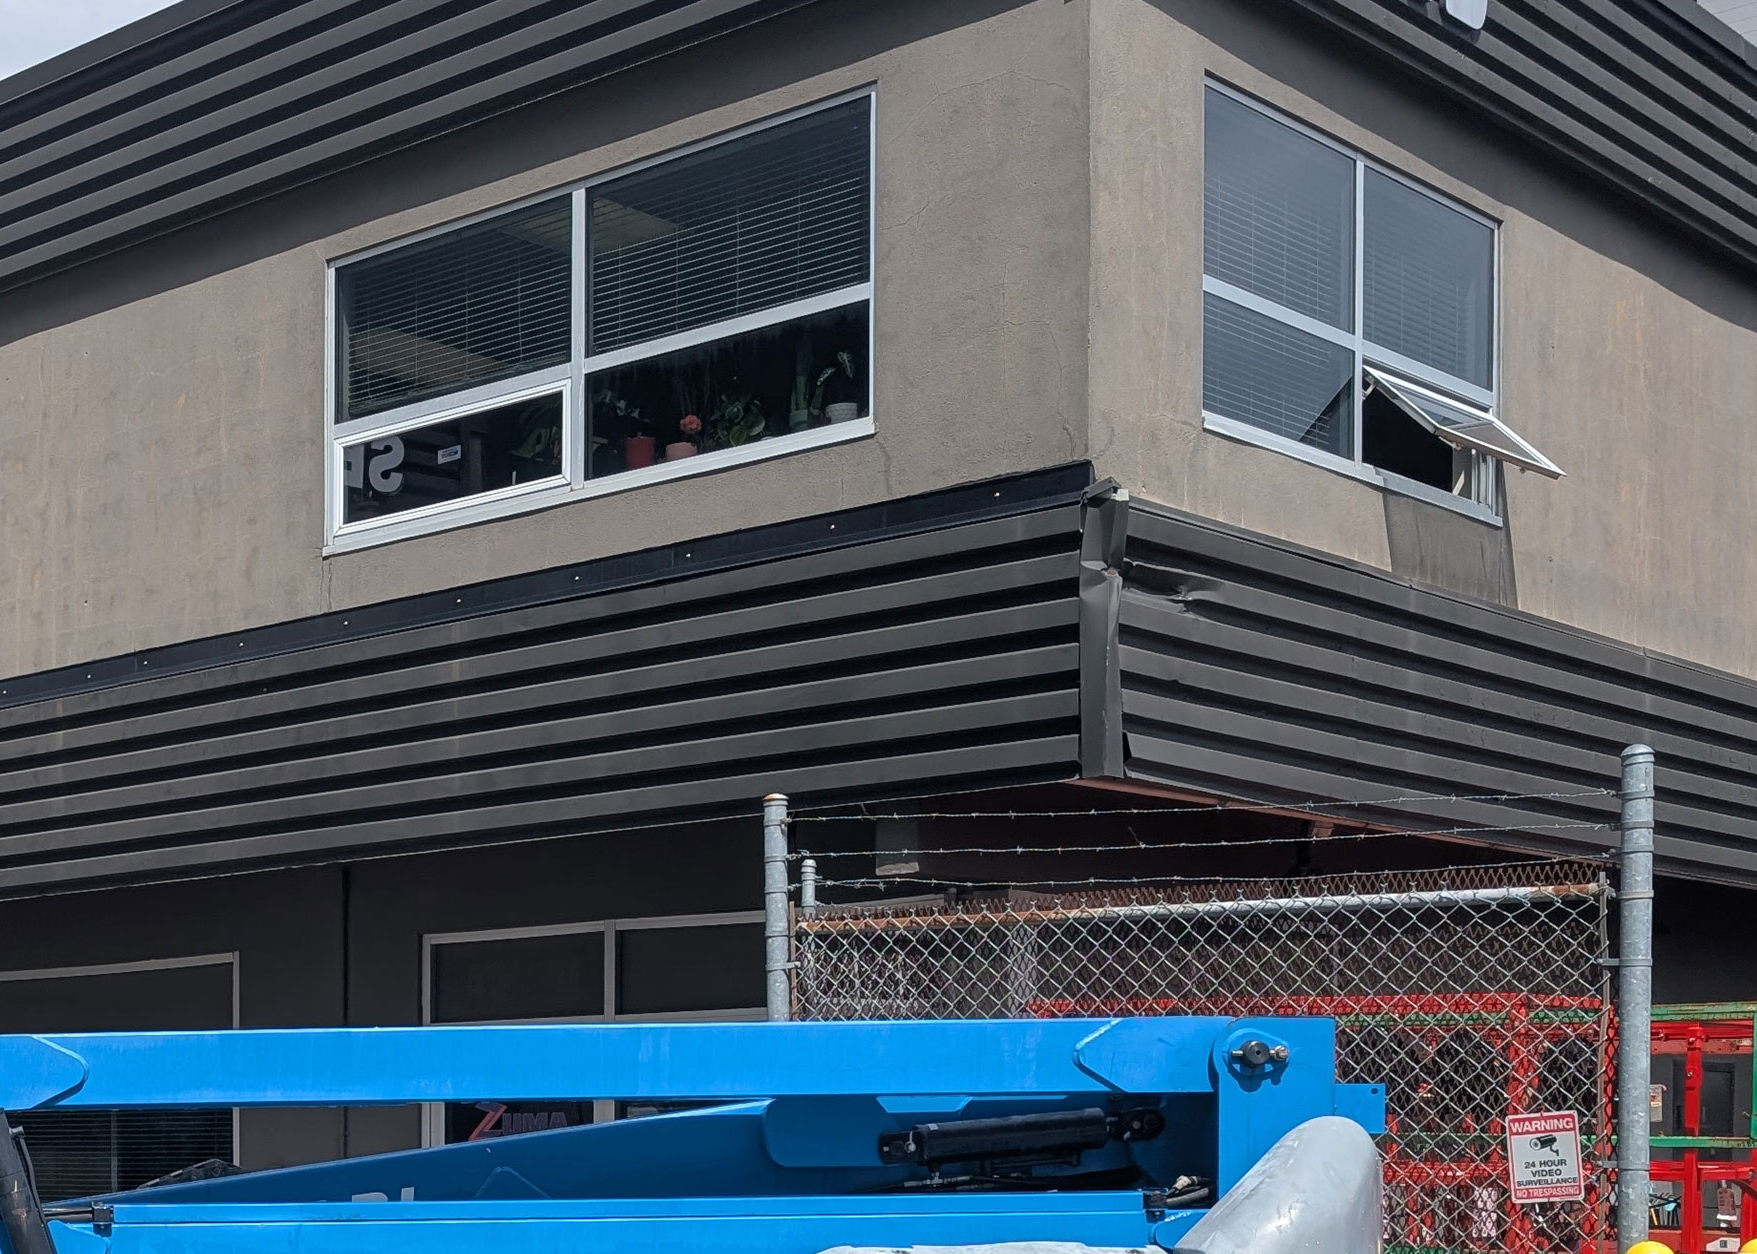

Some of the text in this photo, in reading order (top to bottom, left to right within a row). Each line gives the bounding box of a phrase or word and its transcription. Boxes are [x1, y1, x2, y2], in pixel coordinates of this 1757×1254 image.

[1509, 1117, 1574, 1134] WARNING
[1524, 1158, 1568, 1169] 24 HOUR
[1530, 1168, 1563, 1178] VIDEO
[1516, 1176, 1579, 1188] SURVEILLANCE
[1515, 1186, 1580, 1198] NO TRESPASSING
